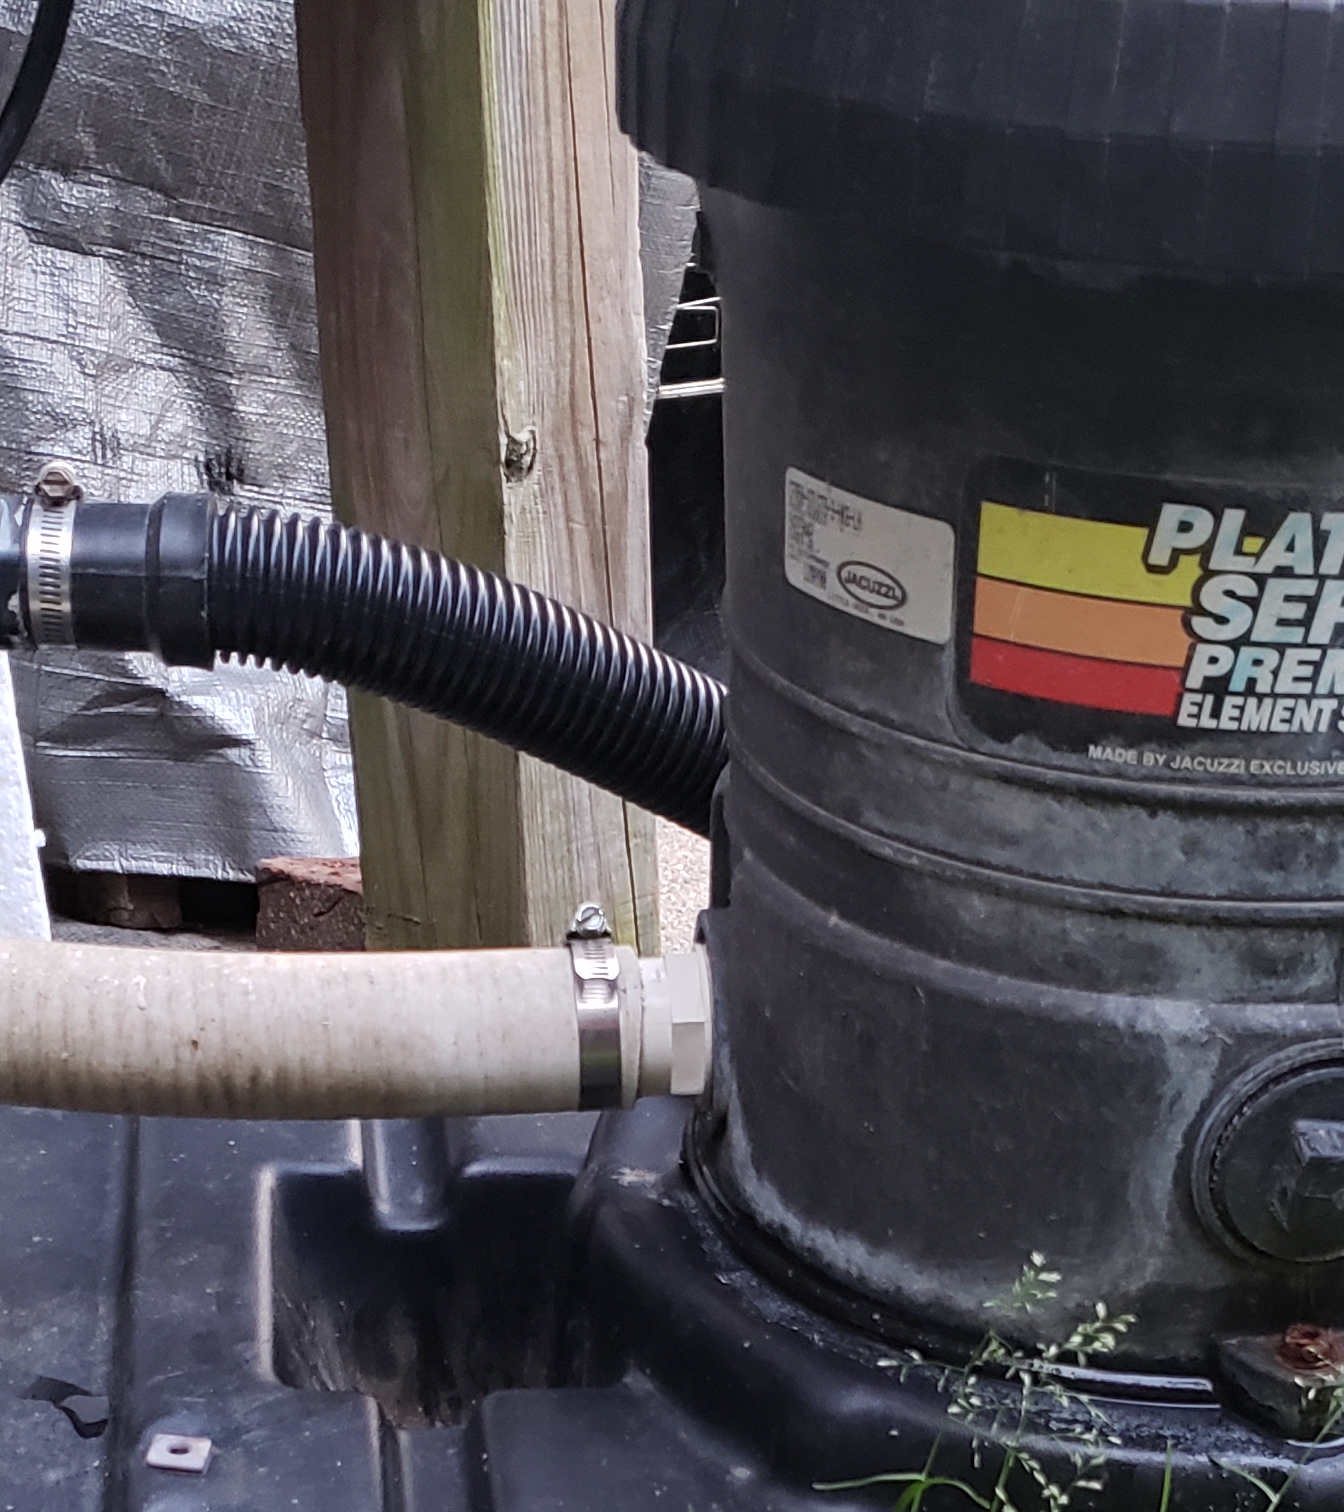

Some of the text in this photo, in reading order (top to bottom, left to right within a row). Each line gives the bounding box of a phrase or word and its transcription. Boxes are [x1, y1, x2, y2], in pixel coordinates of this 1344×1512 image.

[844, 571, 900, 600] JACUZZI
[1176, 693, 1340, 733] ELEMENT
[1086, 744, 1138, 765] MADE
[1142, 753, 1167, 767] BY
[1170, 755, 1246, 773] JACUZZI
